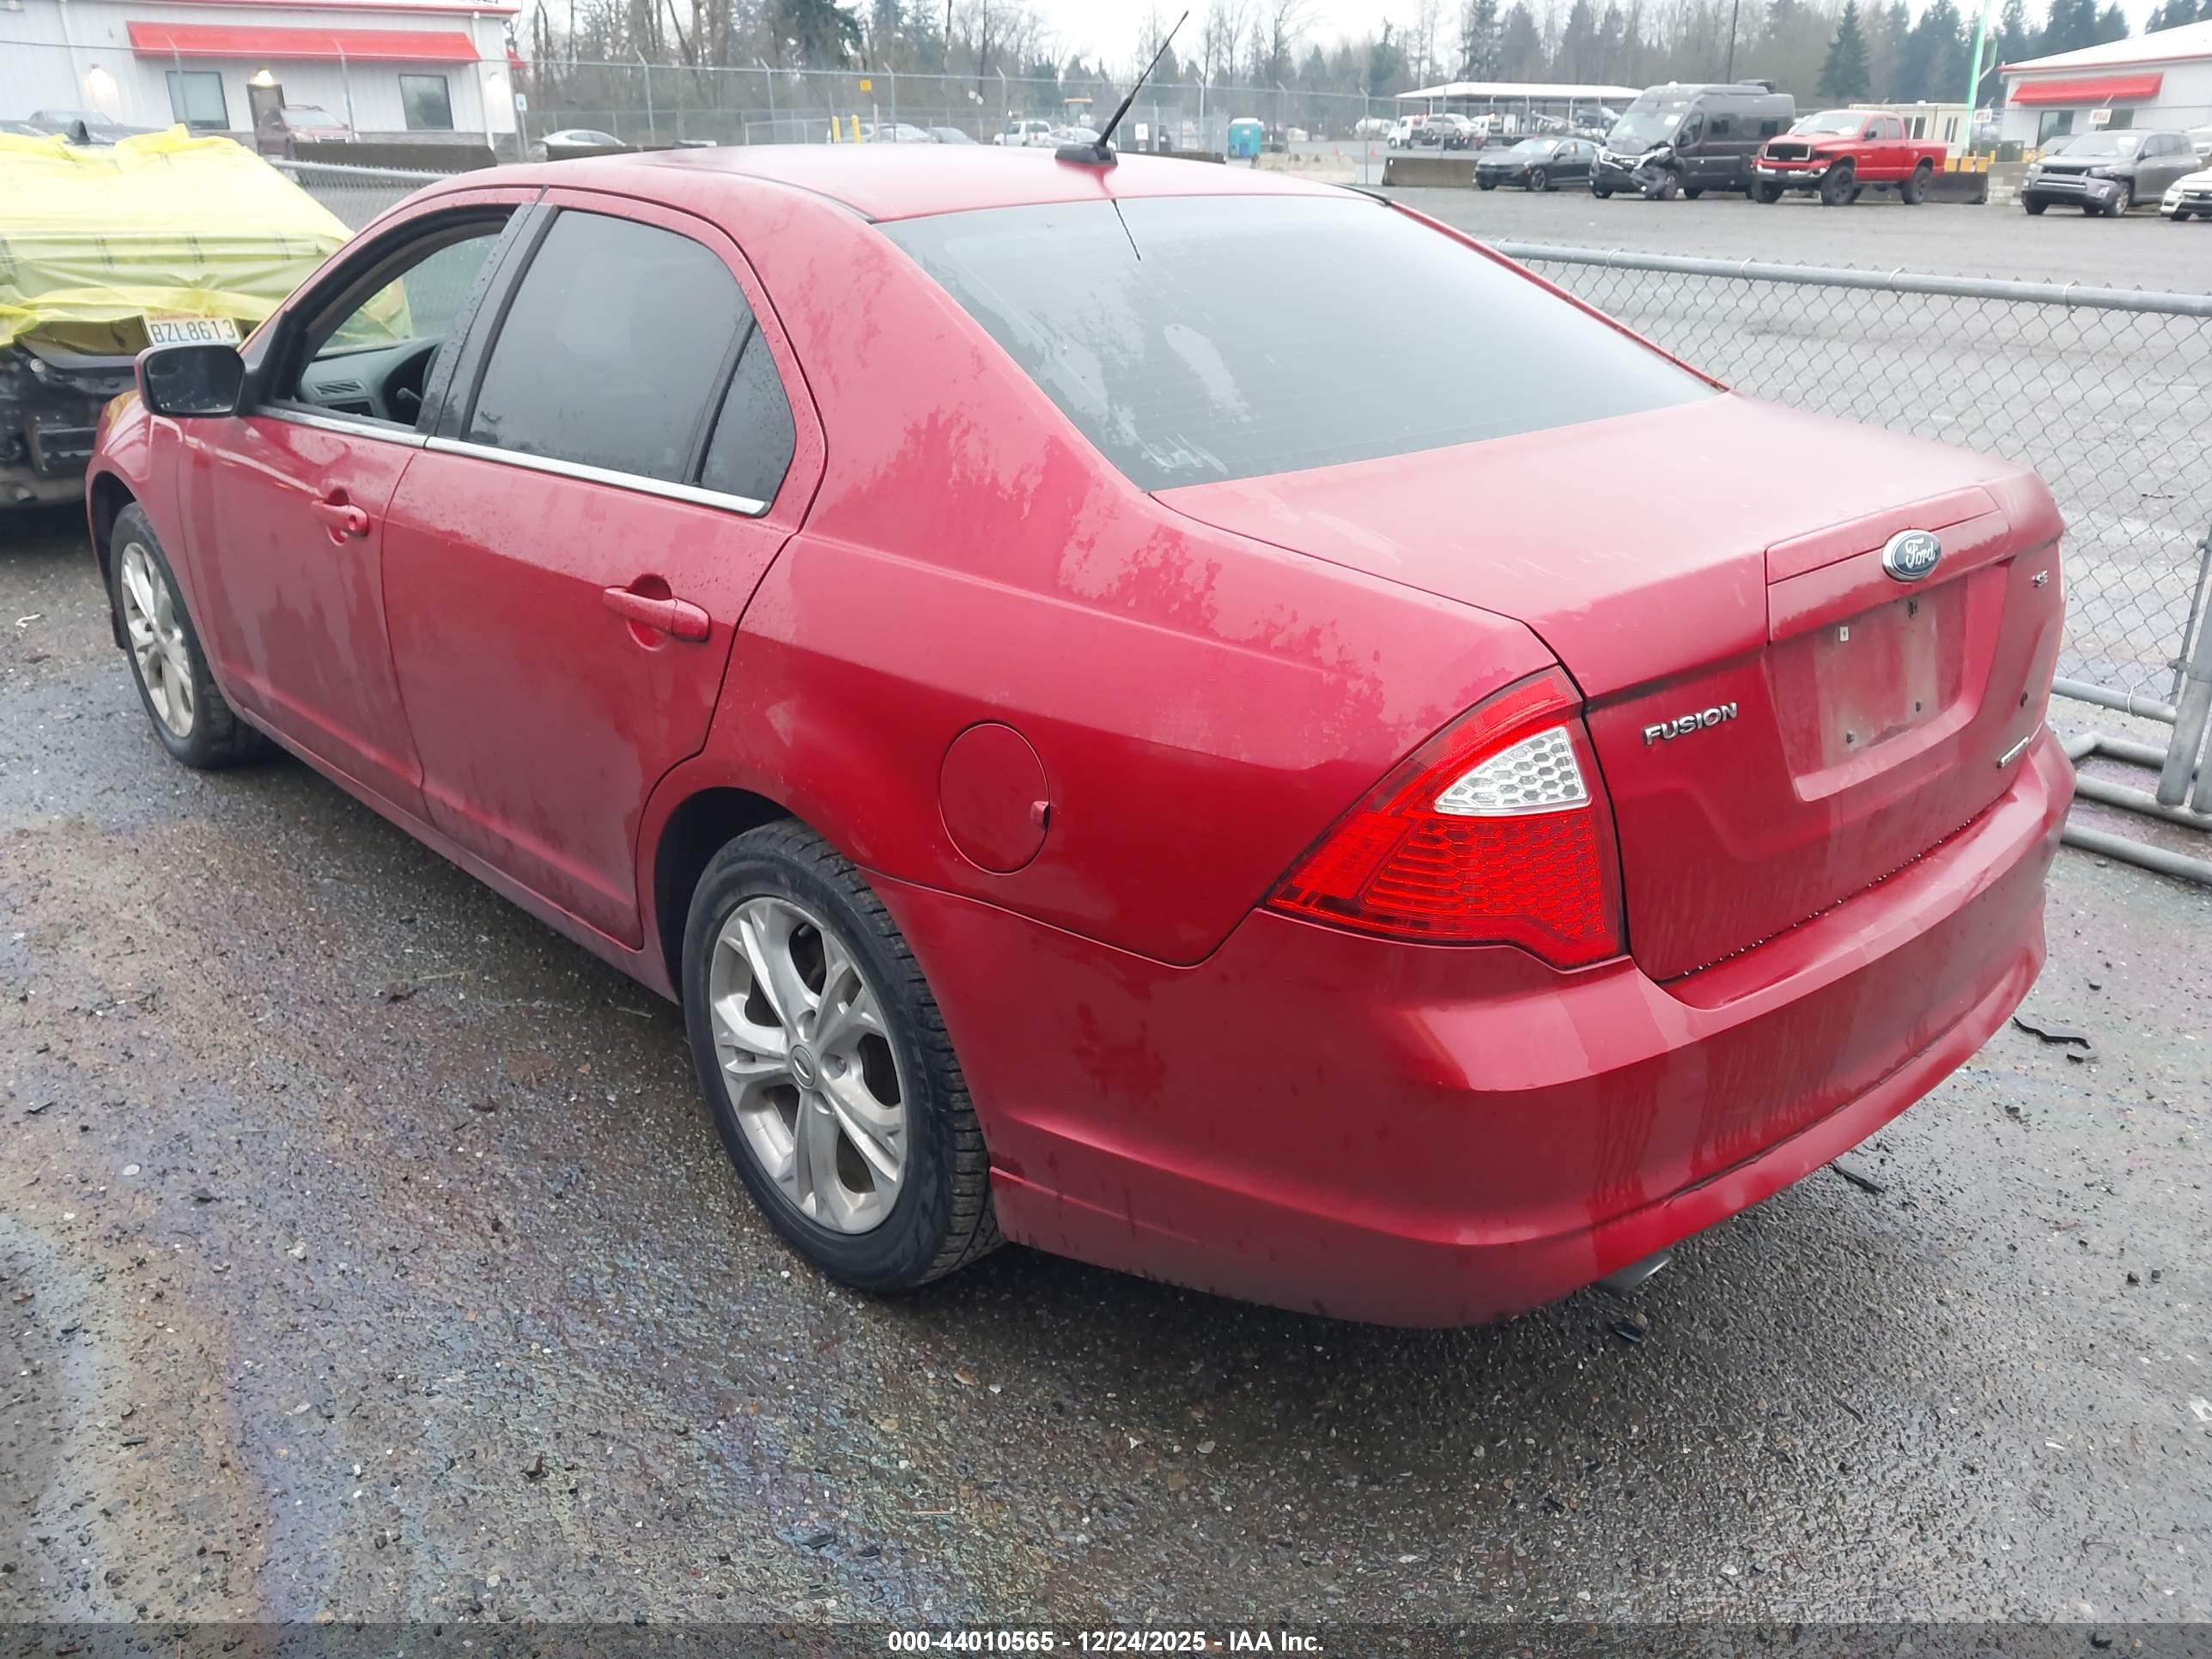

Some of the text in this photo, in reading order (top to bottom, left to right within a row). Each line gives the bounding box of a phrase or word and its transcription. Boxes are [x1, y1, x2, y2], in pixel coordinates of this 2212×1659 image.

[150, 319, 236, 343] BZL8613
[1905, 537, 1936, 568] Ford
[1644, 702, 1737, 745] FUSION
